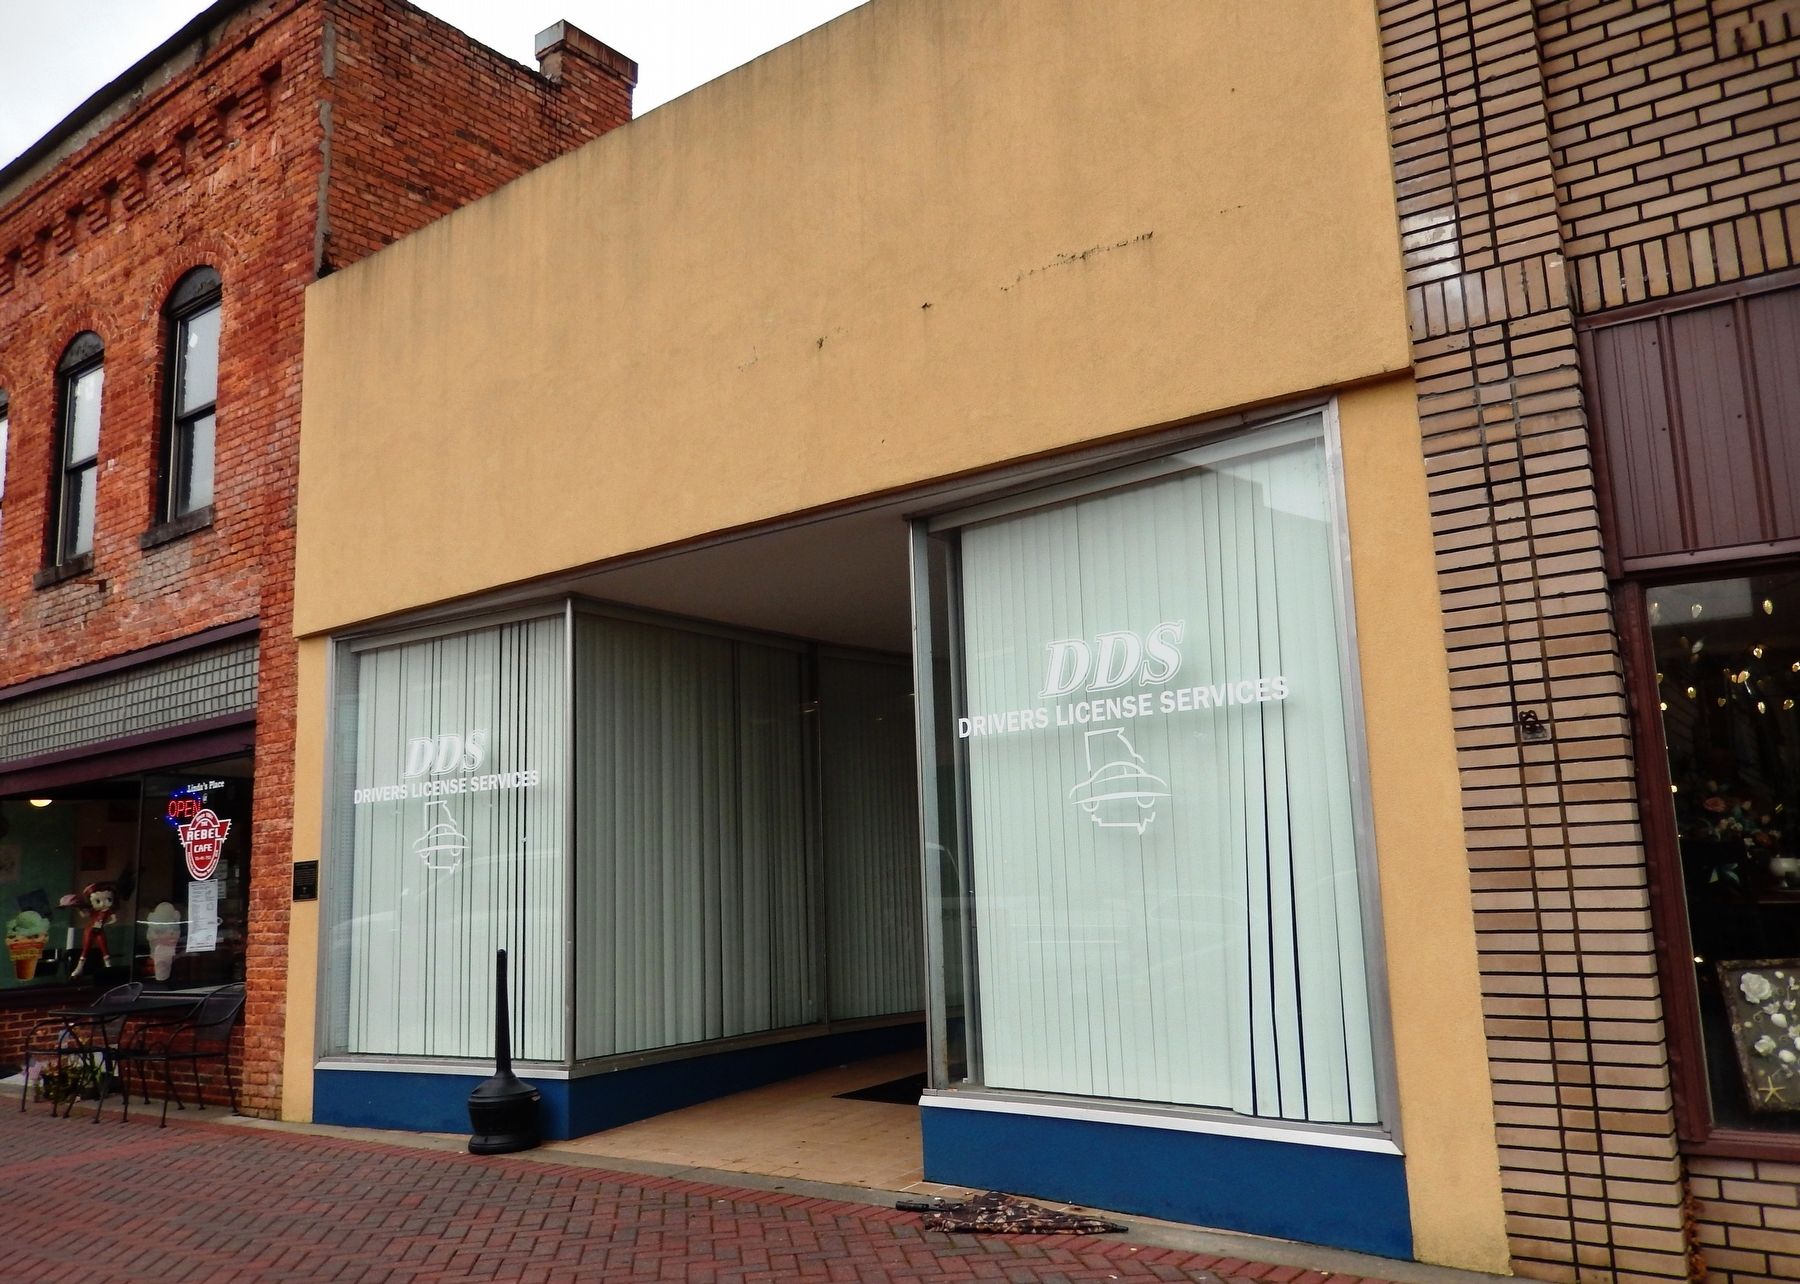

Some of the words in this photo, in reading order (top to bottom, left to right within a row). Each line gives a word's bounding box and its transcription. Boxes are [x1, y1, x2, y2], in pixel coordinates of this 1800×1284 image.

[1039, 619, 1185, 699] DDS
[958, 708, 1049, 739] DRIVERS
[1056, 692, 1153, 727] LICENSE
[1159, 676, 1290, 714] SERVICES
[402, 728, 488, 778] DDS
[354, 784, 409, 804] DRIVERS
[412, 777, 466, 798] LICENSE
[470, 769, 540, 792] SERVICES
[168, 799, 200, 818] OPEN
[186, 828, 222, 841] REBEL
[194, 844, 213, 853] CAFE
